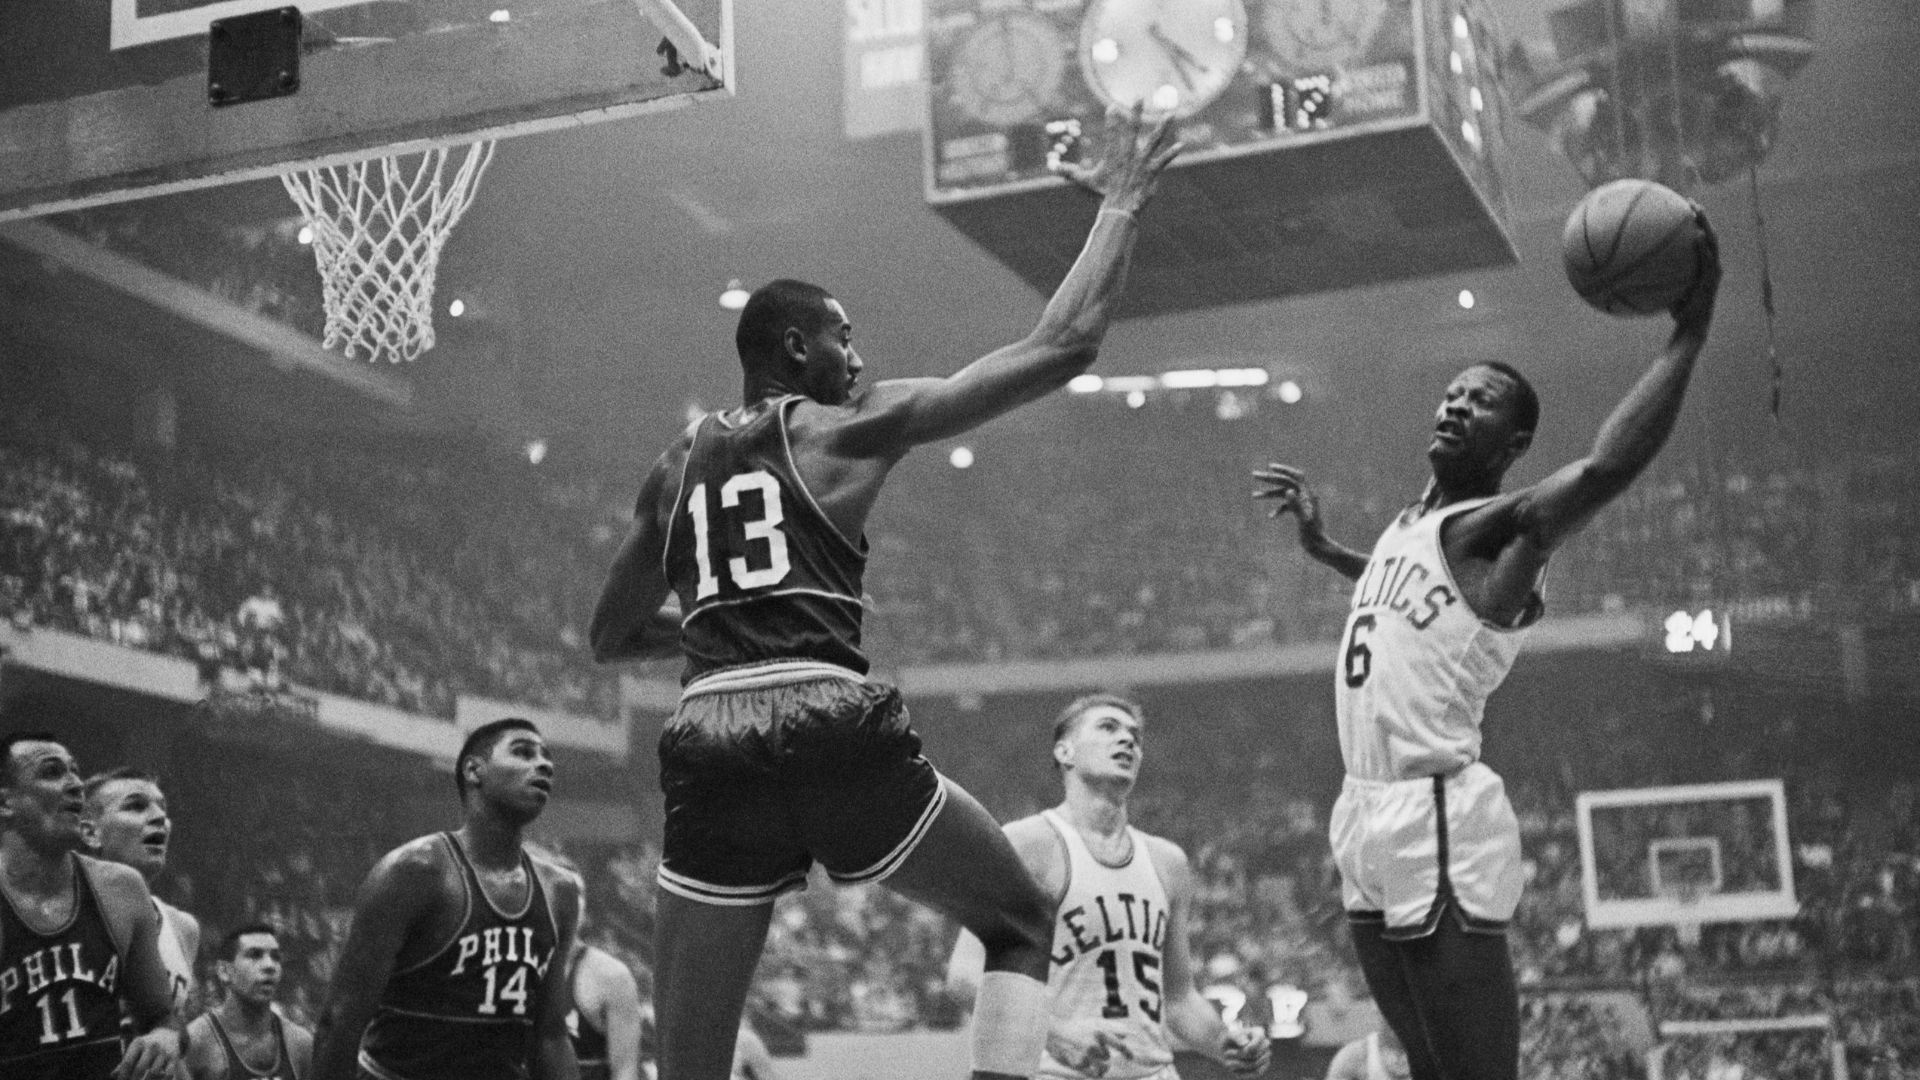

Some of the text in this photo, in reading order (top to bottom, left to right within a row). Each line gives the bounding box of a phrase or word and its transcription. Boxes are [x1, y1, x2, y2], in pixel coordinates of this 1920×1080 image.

[688, 470, 791, 601] 13
[1345, 613, 1377, 689] 6
[0, 942, 118, 1014] PHILA
[478, 966, 528, 1015] 14
[1096, 949, 1162, 1023] 15
[36, 988, 87, 1044] 11
